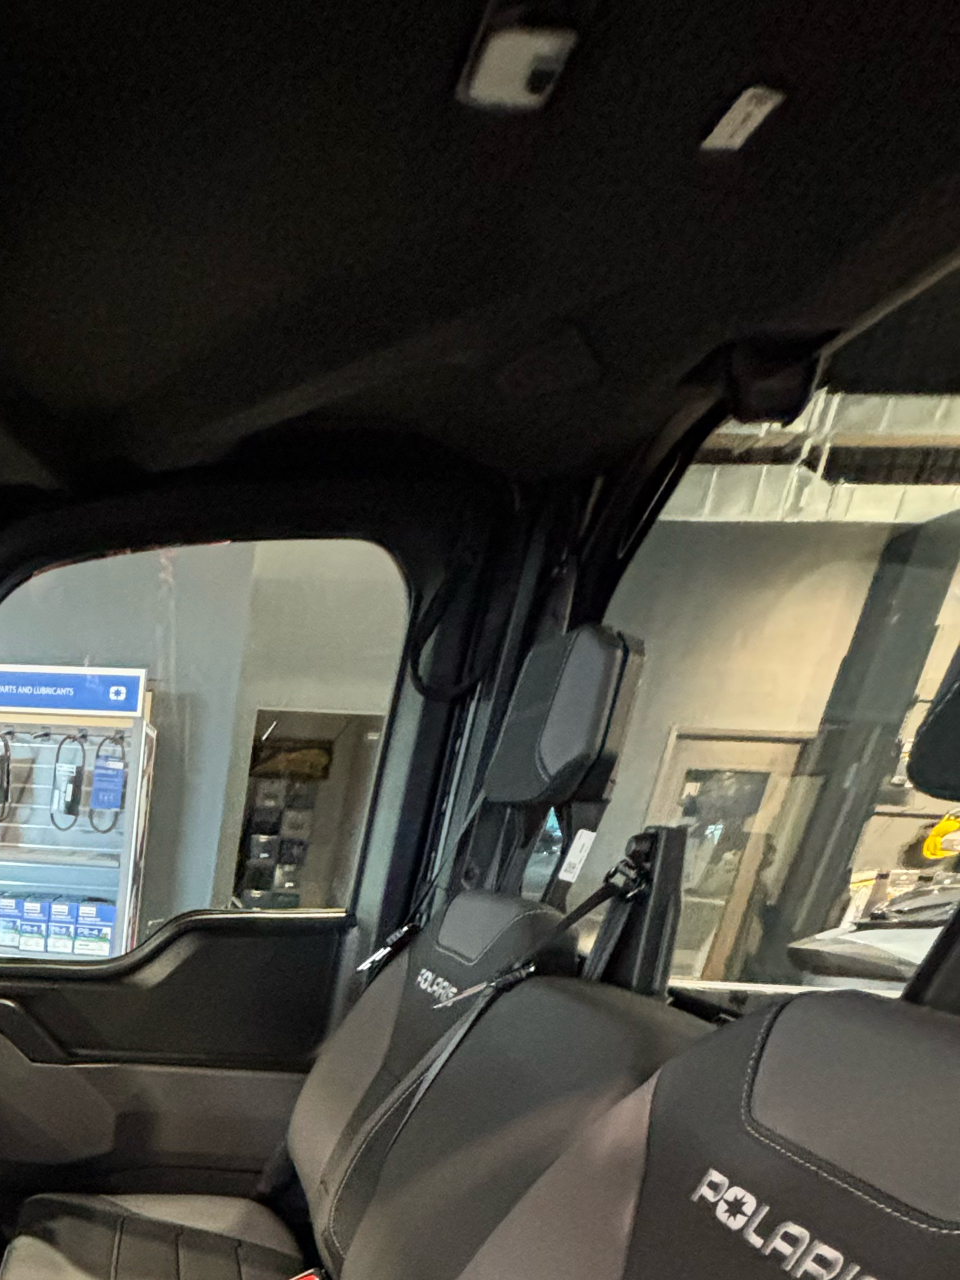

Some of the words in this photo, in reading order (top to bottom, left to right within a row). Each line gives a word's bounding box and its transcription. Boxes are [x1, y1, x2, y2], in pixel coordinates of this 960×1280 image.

[17, 685, 33, 694] AND
[33, 686, 75, 696] LUBRICANTS
[415, 968, 458, 1007] POLARIS
